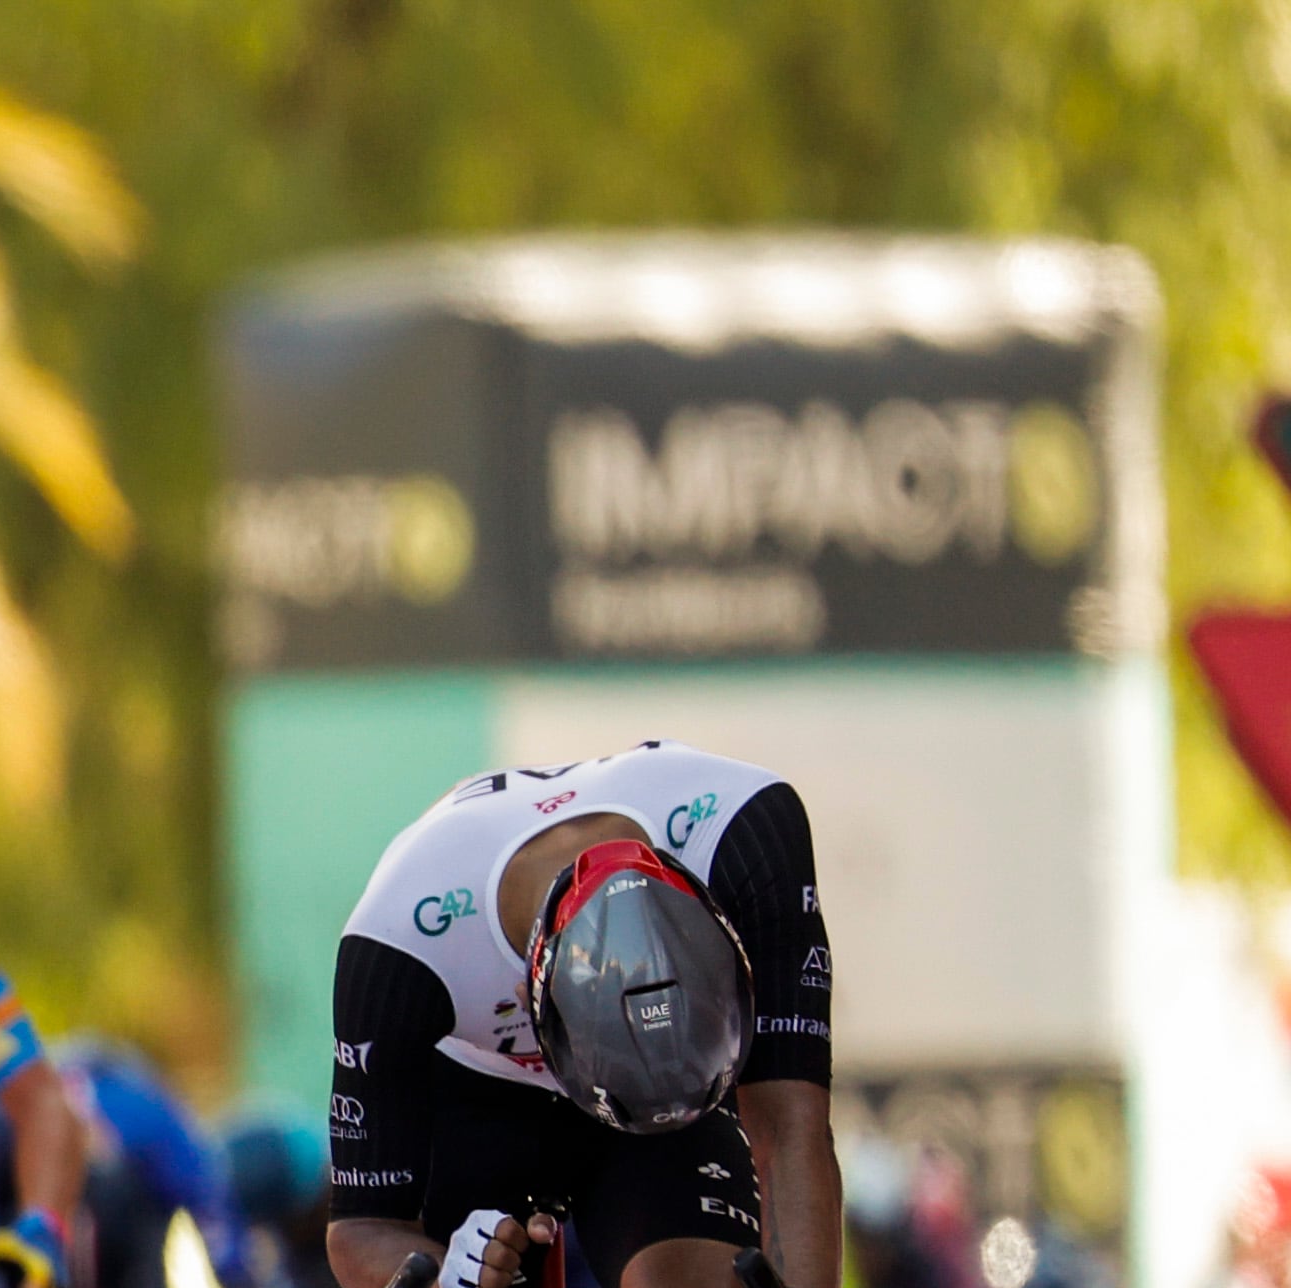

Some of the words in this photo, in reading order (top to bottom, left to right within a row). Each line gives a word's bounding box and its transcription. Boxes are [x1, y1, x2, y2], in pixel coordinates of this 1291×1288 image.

[413, 888, 478, 937] G42
[640, 1003, 670, 1020] UAE
[331, 1166, 413, 1187] Emirates
